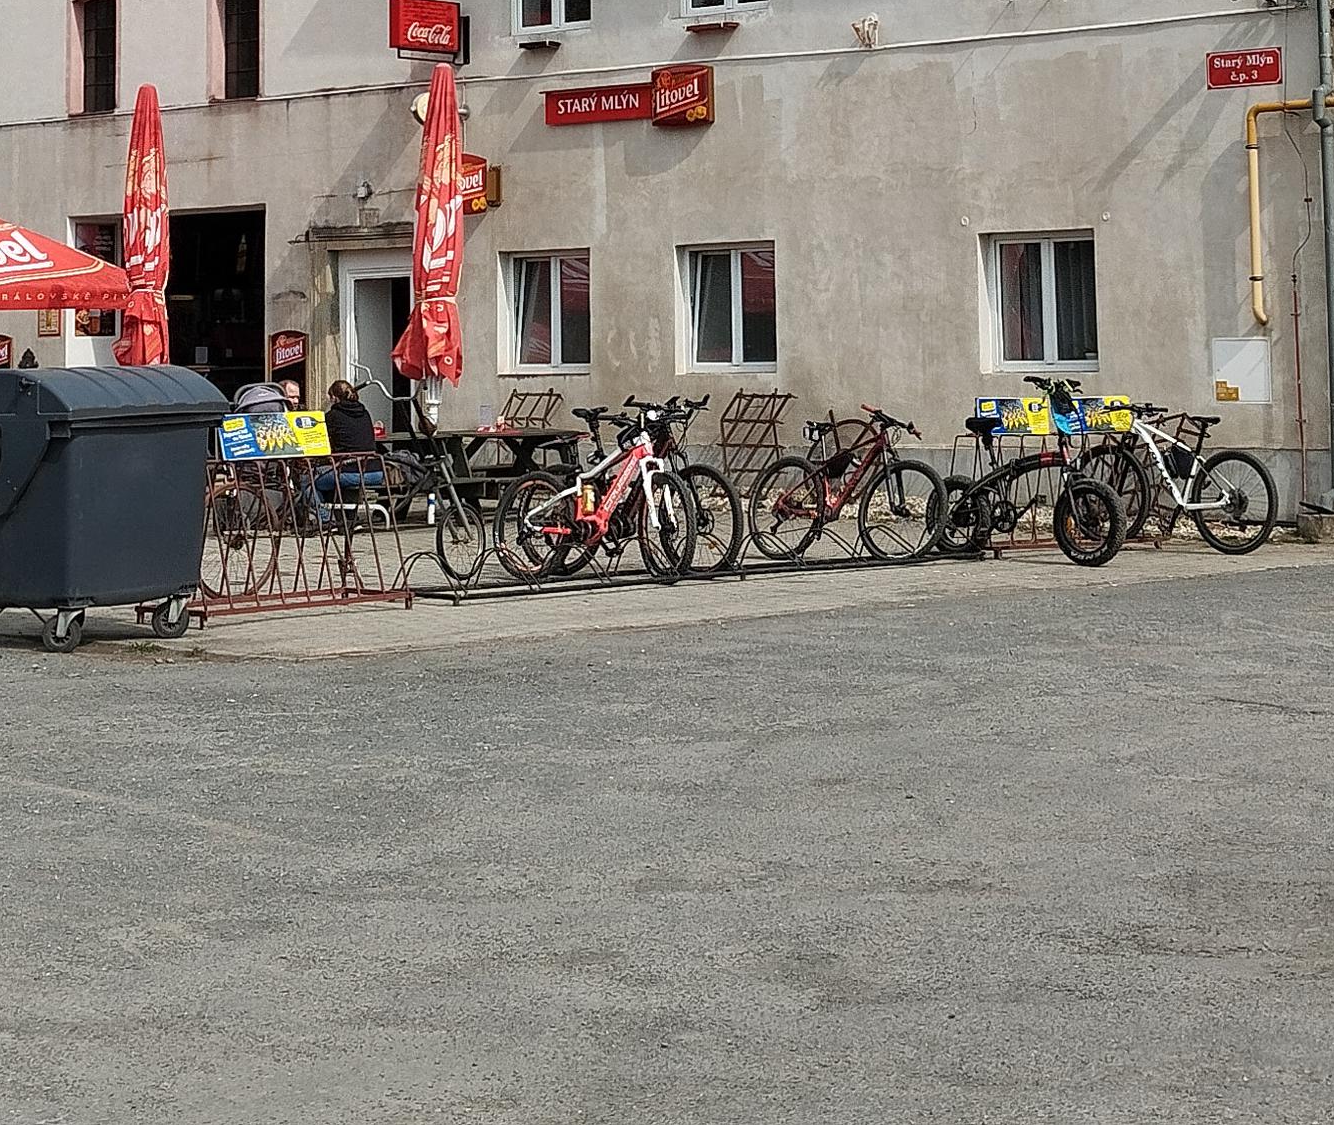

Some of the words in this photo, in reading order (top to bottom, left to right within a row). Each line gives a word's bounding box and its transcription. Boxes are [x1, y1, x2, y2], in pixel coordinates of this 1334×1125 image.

[1214, 56, 1243, 68] Starý
[1246, 53, 1274, 67] Mlýn
[1251, 70, 1258, 79] 3
[557, 92, 598, 115] STARÝ
[601, 89, 639, 111] MLÝN
[656, 78, 699, 113] Litovel
[460, 169, 483, 191] ovel
[102, 293, 128, 301] PIV
